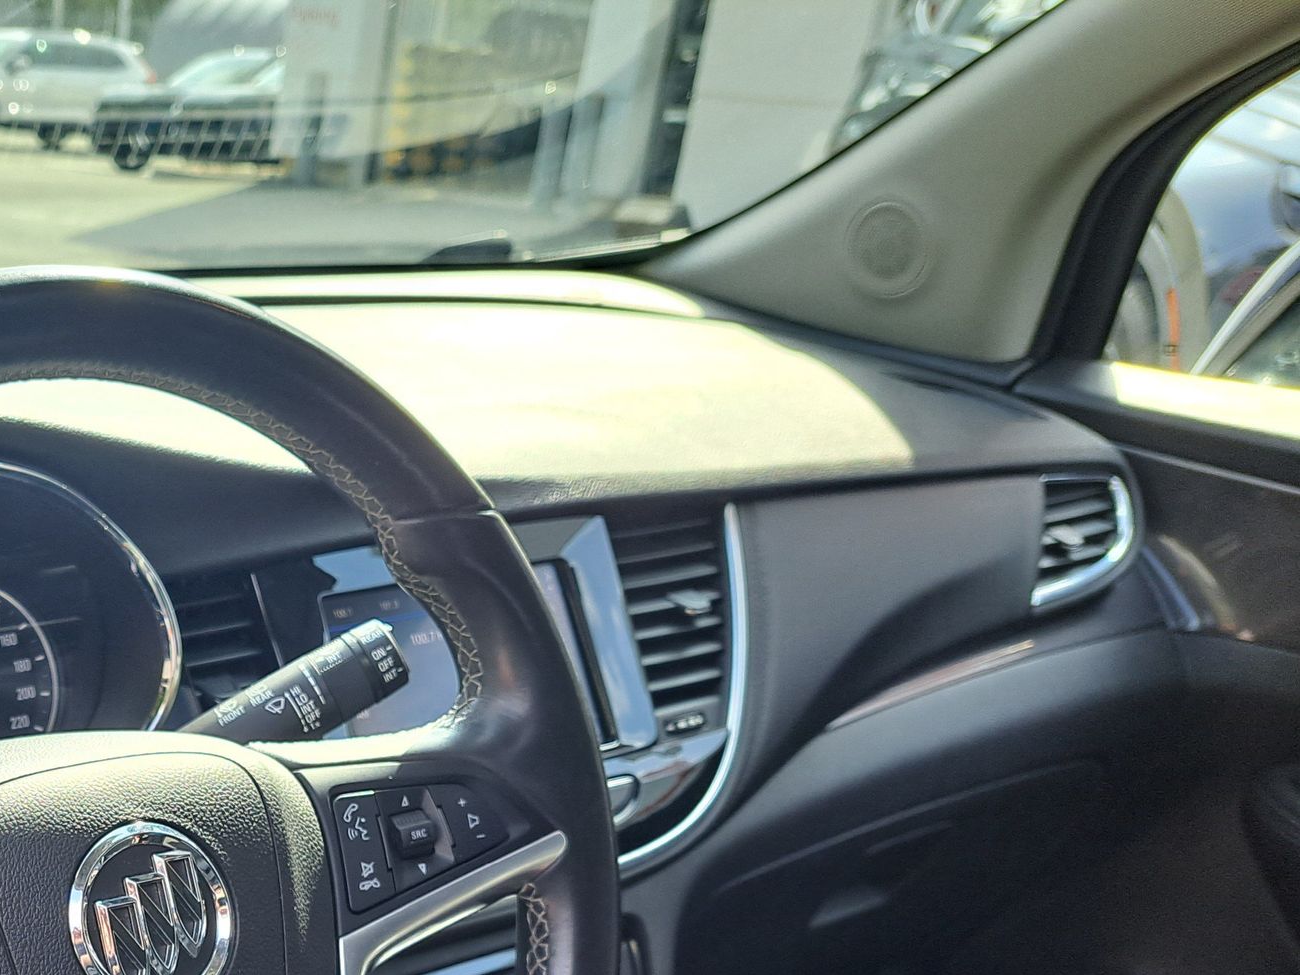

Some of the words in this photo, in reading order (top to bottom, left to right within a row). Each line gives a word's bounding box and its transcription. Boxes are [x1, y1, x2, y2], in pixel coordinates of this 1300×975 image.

[0, 633, 18, 647] 160
[325, 651, 342, 664] INT
[371, 647, 388, 661] ON
[13, 658, 32, 673] 180
[378, 657, 394, 673] OFF
[383, 669, 397, 683] INT
[16, 686, 36, 701] 200
[249, 689, 274, 707] REAR
[290, 685, 302, 697] HI
[295, 693, 309, 706] LO
[300, 699, 316, 715] INT
[10, 715, 30, 730] 220
[218, 705, 246, 727] FRONT
[305, 708, 321, 724] OFF
[411, 828, 428, 841] SRC
